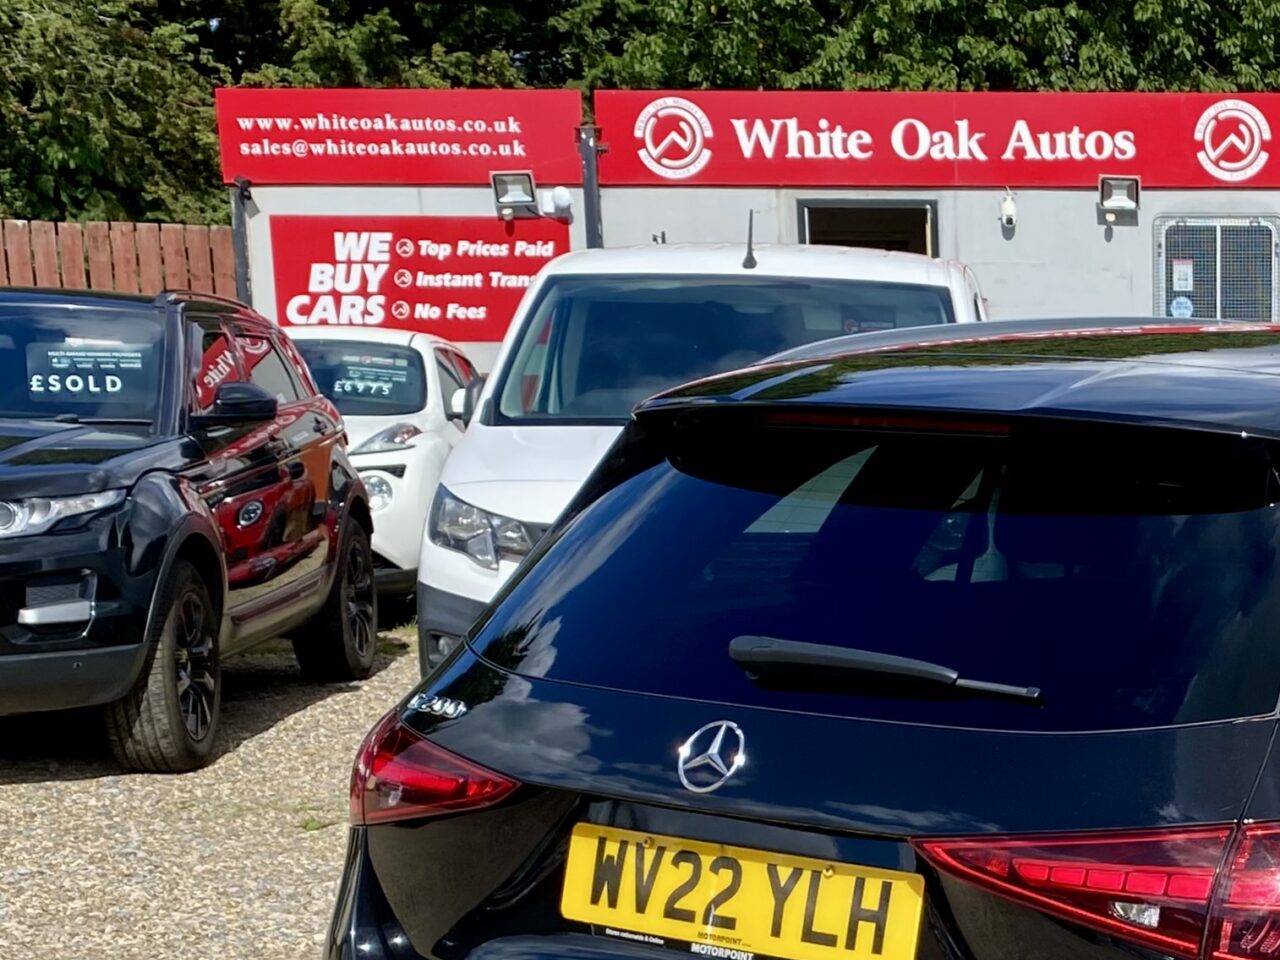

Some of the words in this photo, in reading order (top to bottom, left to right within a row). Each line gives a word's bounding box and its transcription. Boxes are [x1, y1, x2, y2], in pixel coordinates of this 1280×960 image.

[236, 113, 521, 134] www.whiteoakautos.co.uk
[239, 138, 526, 158] sales@whiteoakautos.co.uk
[730, 116, 873, 160] White
[890, 118, 989, 162] Oak
[1000, 119, 1137, 161] Autos
[333, 231, 393, 263] WE
[417, 239, 452, 261] Top
[456, 240, 510, 258] Prices
[513, 240, 556, 258] Paid
[308, 263, 391, 294] BUY
[415, 271, 484, 288] Instant
[285, 294, 387, 325] CARS
[413, 303, 442, 320] No
[446, 303, 487, 320] Fees
[29, 374, 122, 392] £SOLD
[590, 836, 743, 932] WV22
[766, 862, 894, 955] YLH
[697, 931, 743, 946] MOTORPOINT
